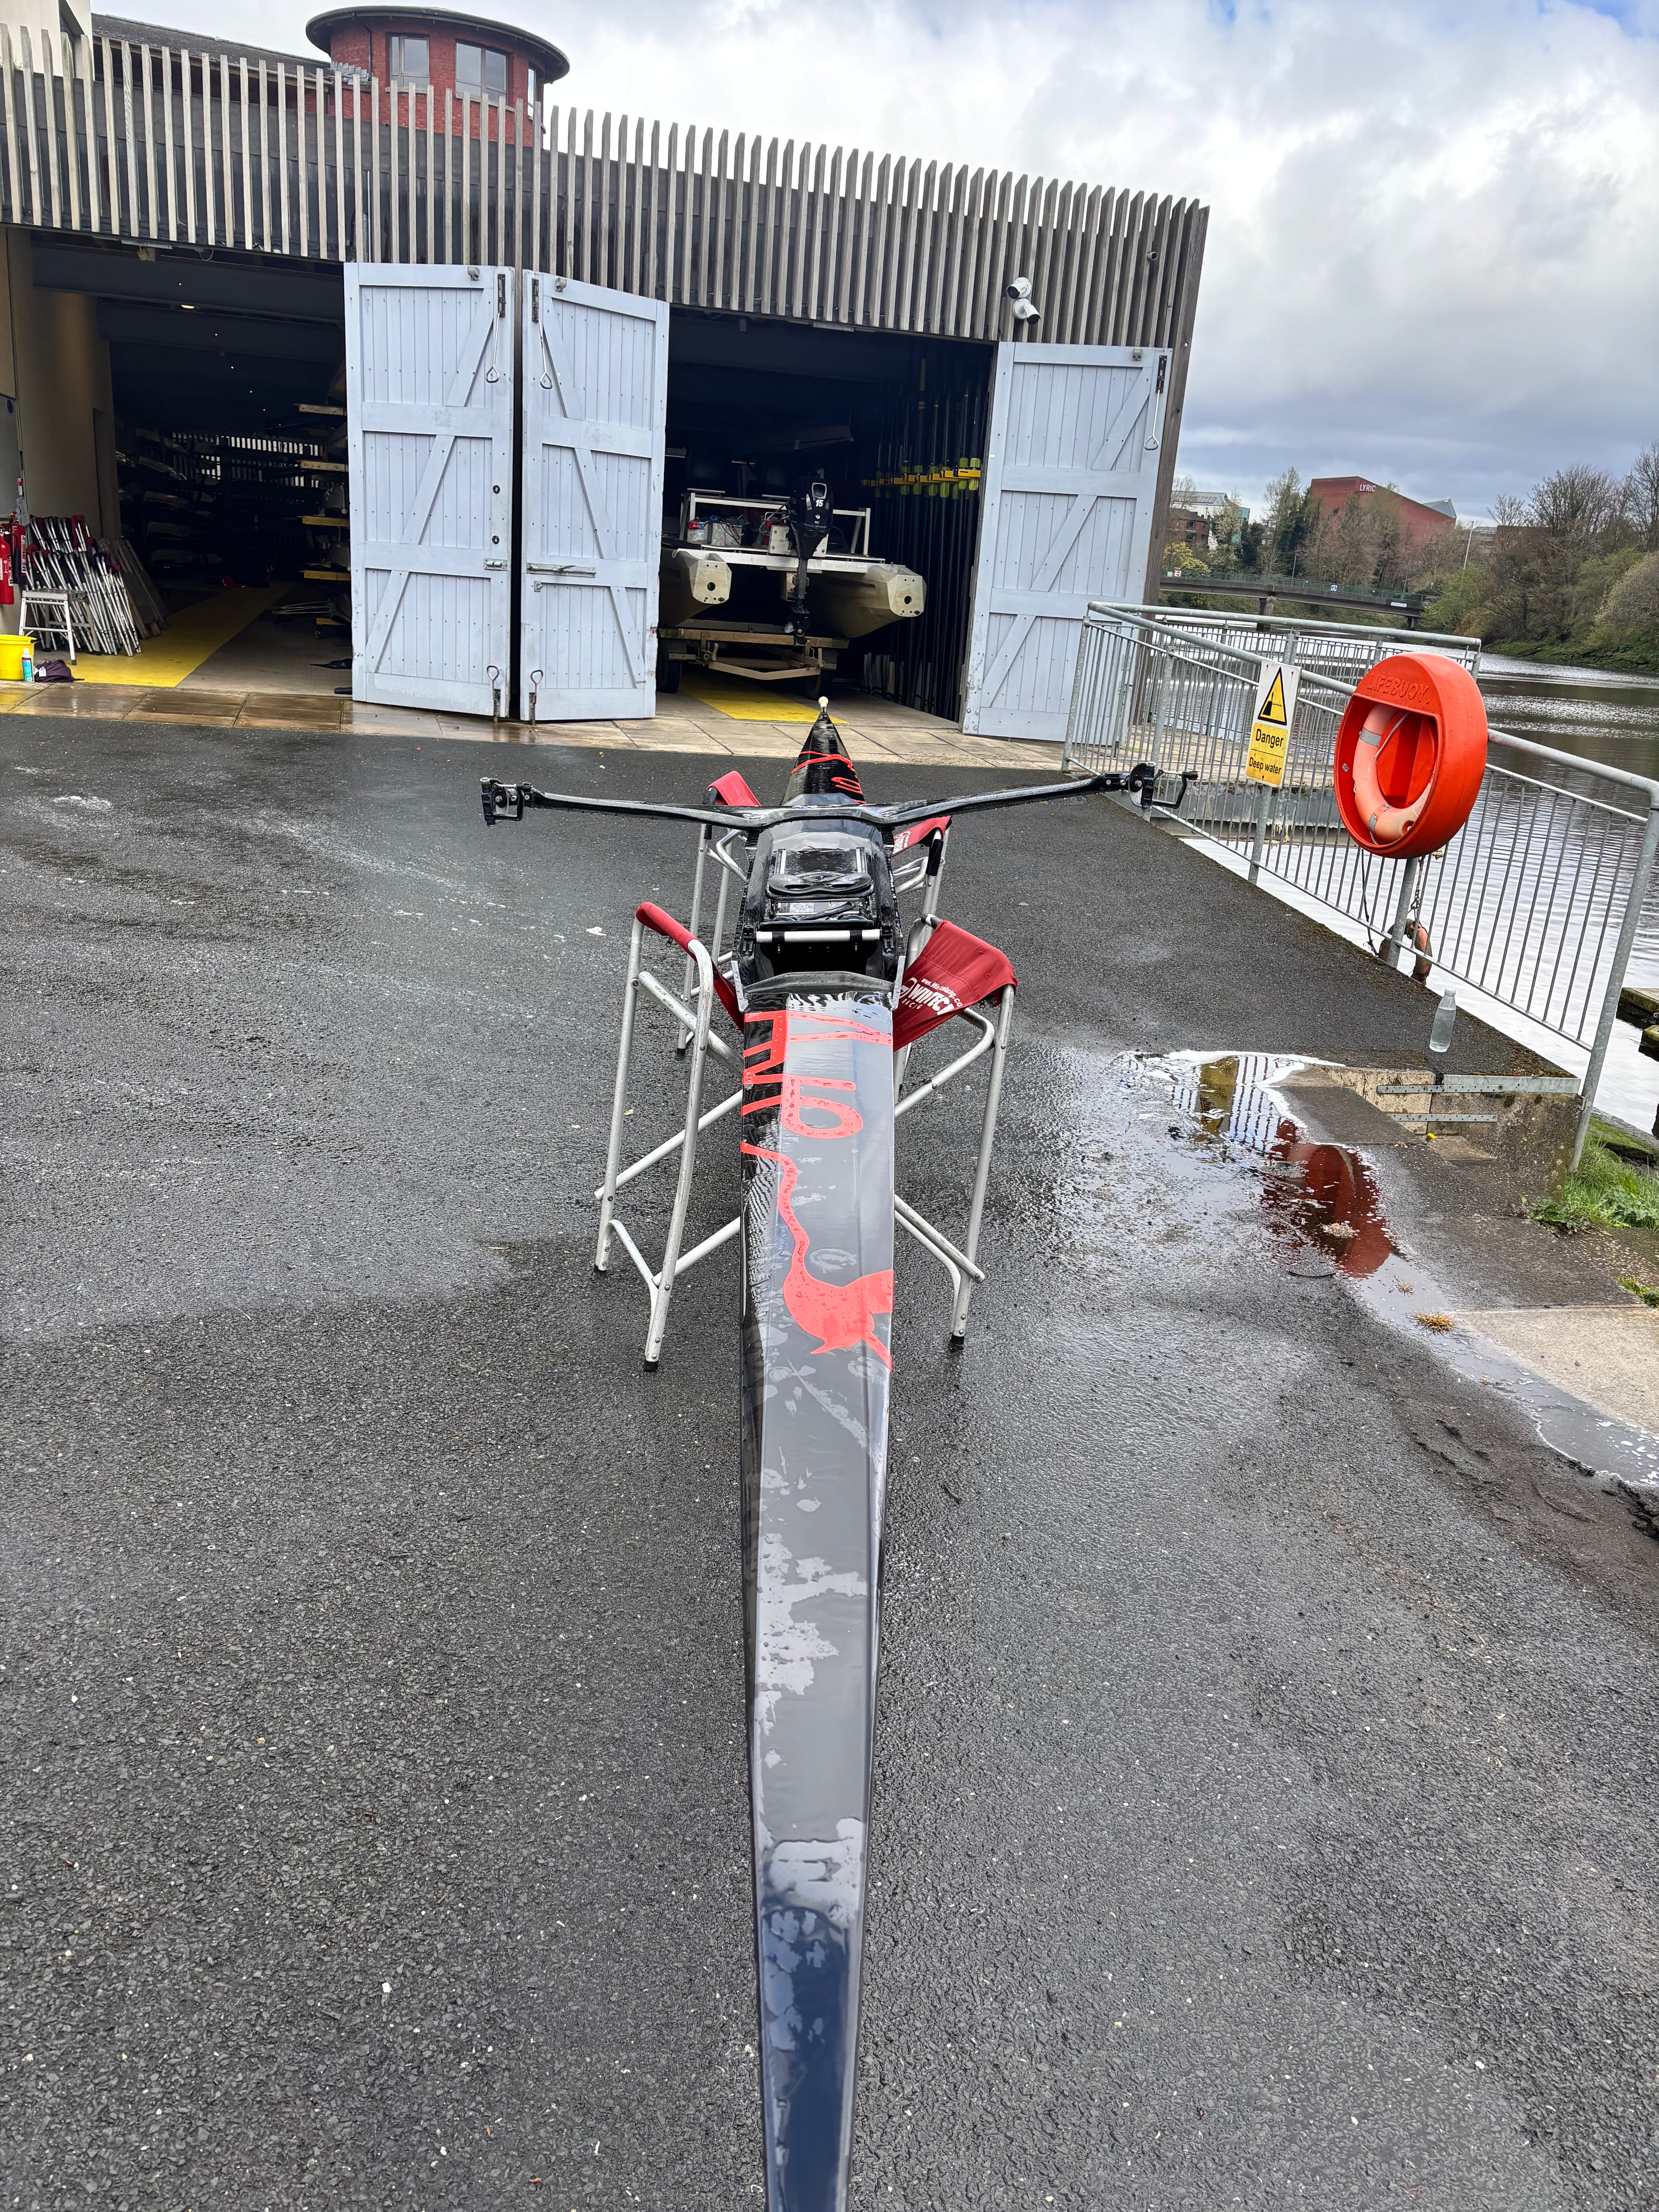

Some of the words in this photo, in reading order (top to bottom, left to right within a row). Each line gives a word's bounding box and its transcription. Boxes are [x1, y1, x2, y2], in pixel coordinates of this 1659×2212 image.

[1255, 728, 1284, 748] Danger
[1249, 757, 1263, 772] Deep
[1265, 764, 1281, 775] water
